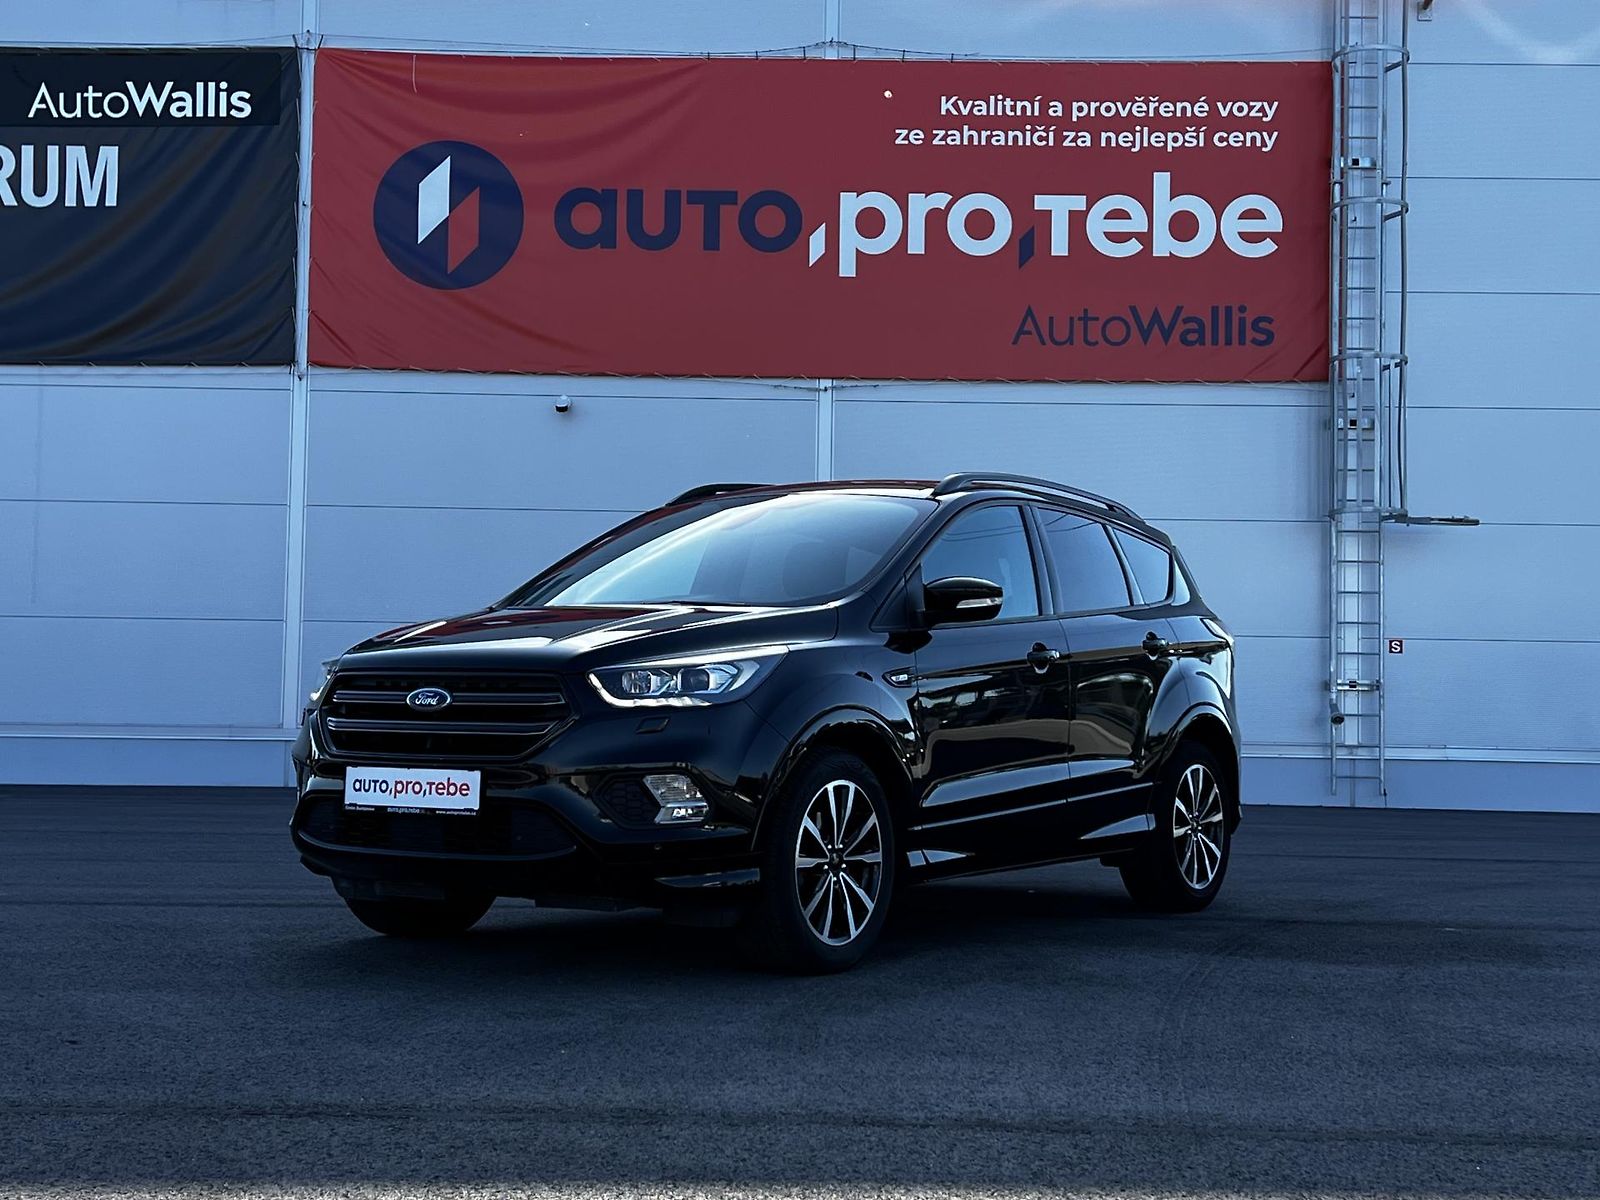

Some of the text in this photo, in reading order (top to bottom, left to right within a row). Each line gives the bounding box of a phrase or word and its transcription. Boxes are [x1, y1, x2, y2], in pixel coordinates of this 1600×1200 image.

[28, 81, 252, 118] AutoWallis
[940, 94, 1279, 122] Kvalitní a prověřené vozy
[895, 124, 1279, 152] ze zahraničí za nejlepší ceny
[1011, 304, 1276, 347] AutoWallis
[1391, 641, 1401, 652] S
[415, 692, 440, 705] Ford
